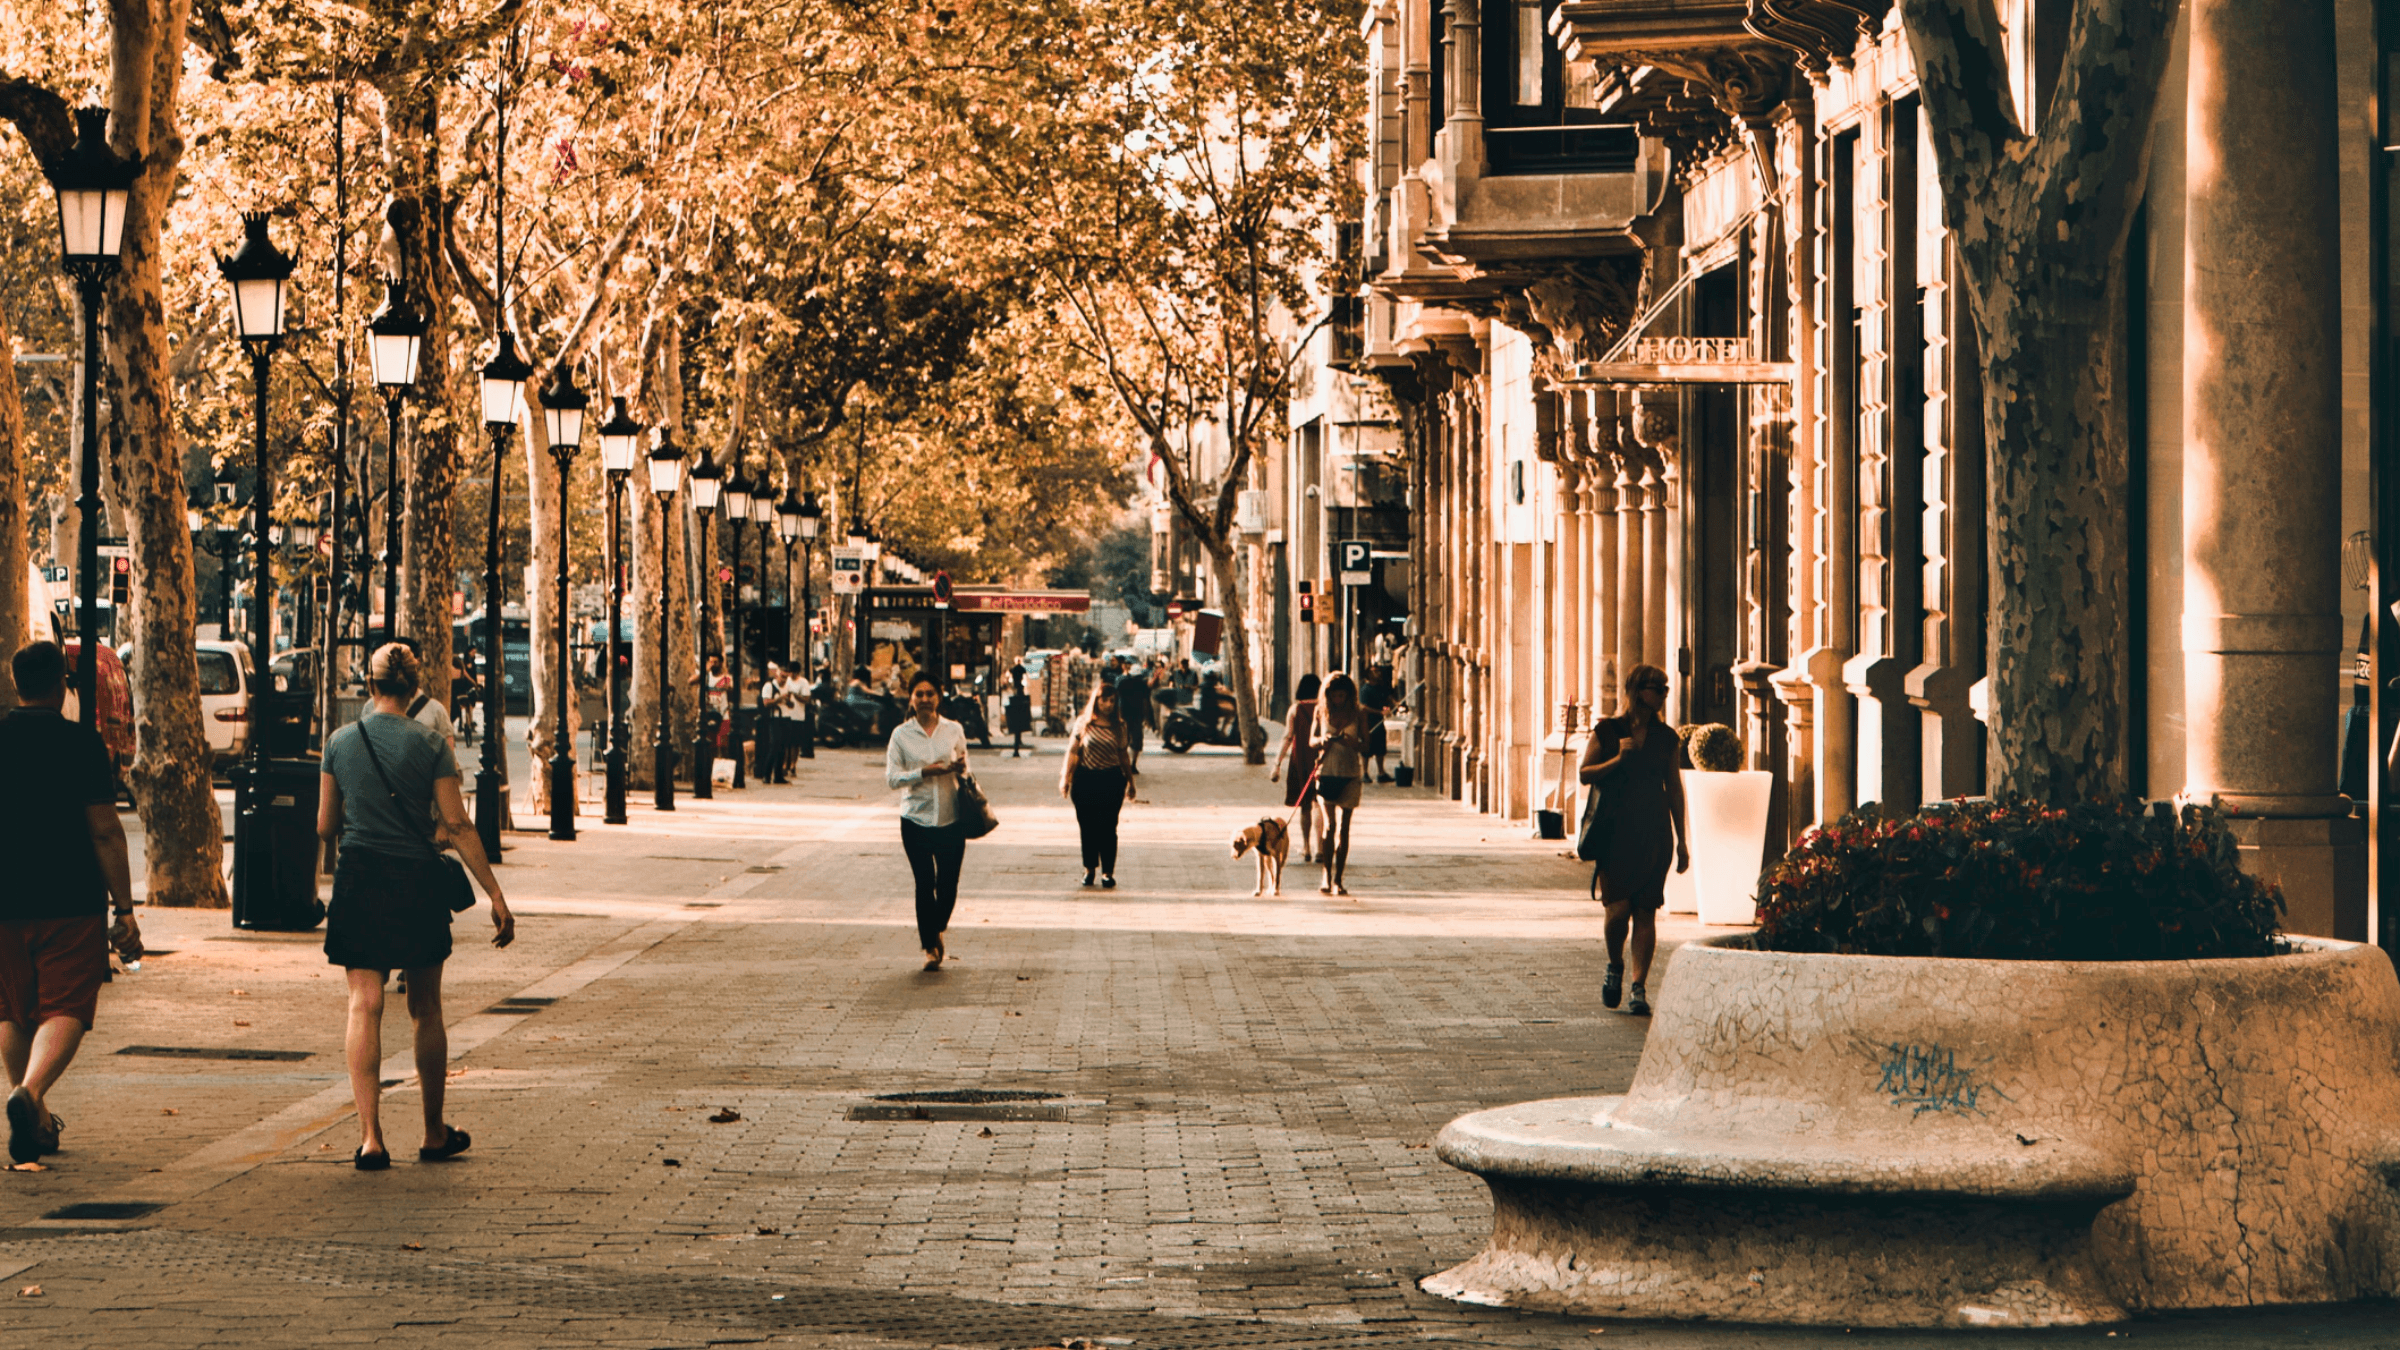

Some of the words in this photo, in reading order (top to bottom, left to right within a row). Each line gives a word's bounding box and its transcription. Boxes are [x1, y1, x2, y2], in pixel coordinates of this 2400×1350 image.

[1639, 336, 1761, 365] HOTEL
[1346, 544, 1365, 568] P
[56, 568, 66, 580] P
